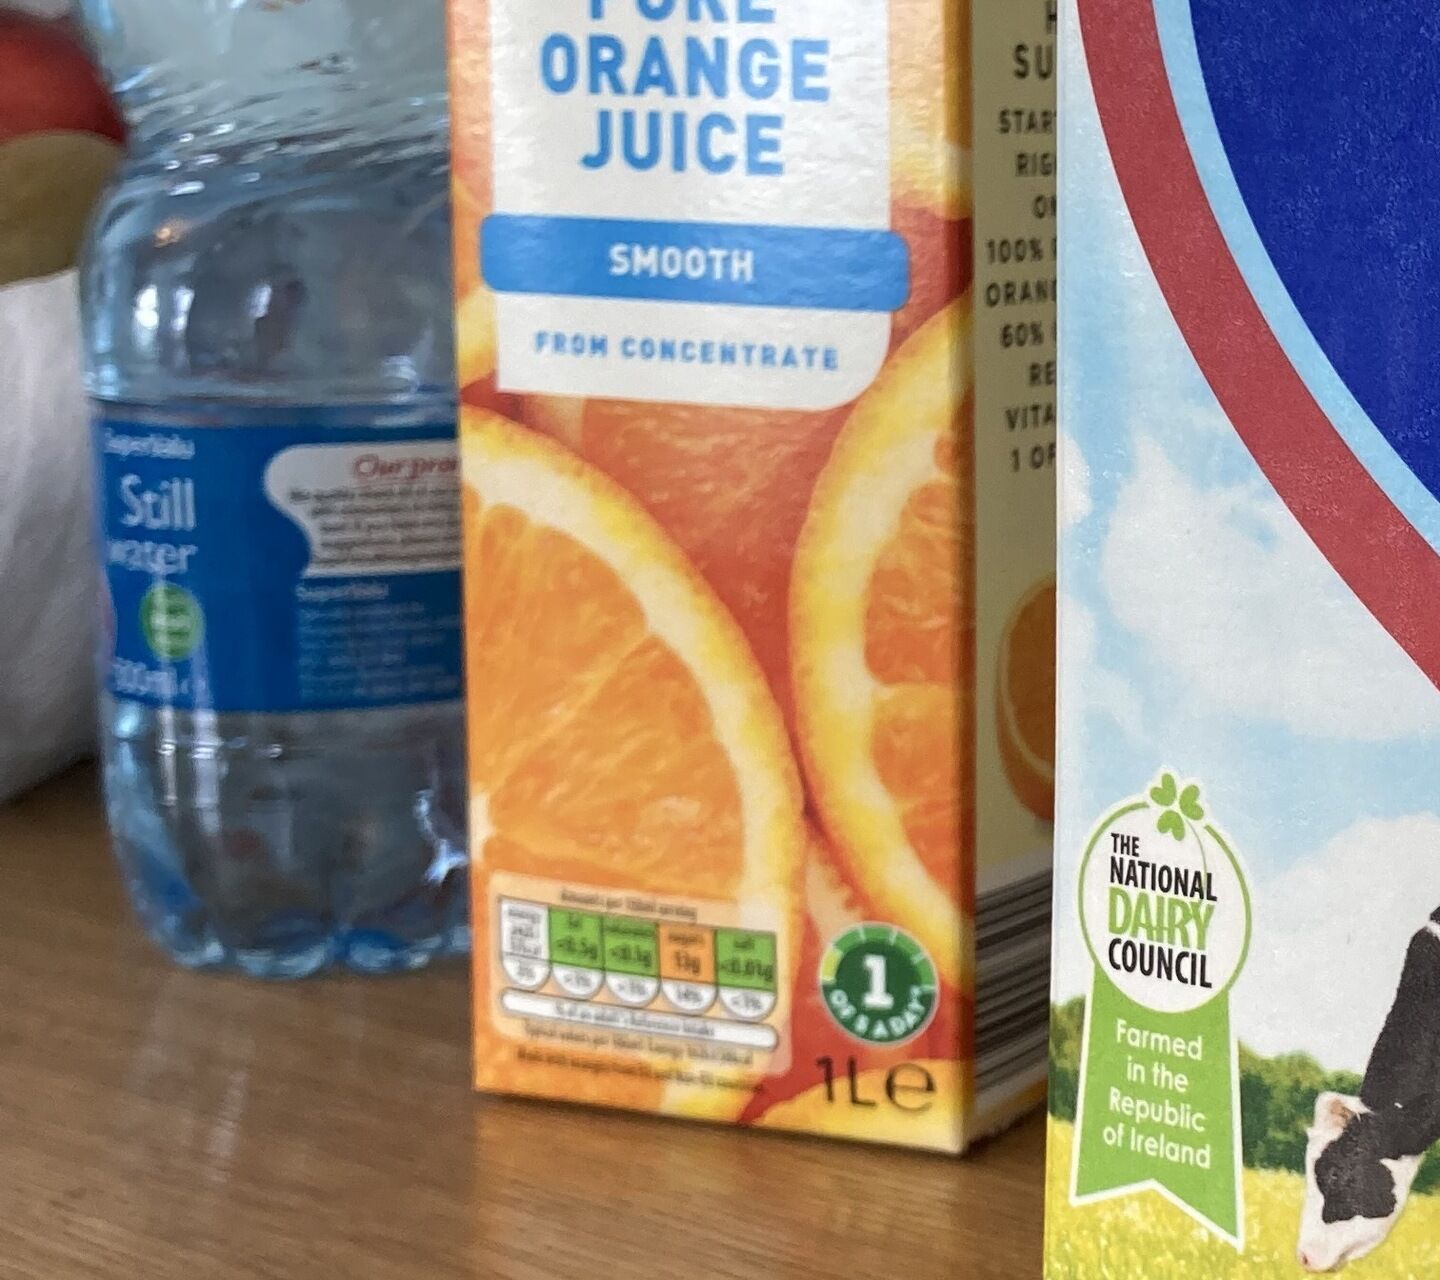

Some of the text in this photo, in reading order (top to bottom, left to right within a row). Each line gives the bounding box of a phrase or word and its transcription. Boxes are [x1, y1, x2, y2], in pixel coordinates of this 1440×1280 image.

[539, 34, 831, 102] ORANGE
[1013, 43, 1055, 80] SU
[998, 109, 1057, 134] STAR
[580, 109, 786, 177] JUICE
[1015, 152, 1057, 177] RIG
[608, 242, 755, 283] SMOOTH
[985, 238, 1044, 265] 100%
[985, 280, 1057, 308] ORAN
[535, 331, 839, 372] FROM CONCENTRATE
[1001, 322, 1045, 349] 60%
[1005, 403, 1057, 431] VITA
[1010, 449, 1021, 472] 1
[119, 472, 196, 532] Still
[1110, 832, 1140, 858] THE
[1109, 855, 1218, 903] NATIONAL
[1107, 886, 1216, 952] DAIRY
[862, 953, 895, 1011] 1
[1107, 937, 1214, 990] COUNCIL
[1115, 1018, 1203, 1062] Farmed
[815, 1054, 878, 1108] 1L
[1126, 1054, 1190, 1094] in the
[1109, 1087, 1207, 1134] Republic
[1102, 1125, 1212, 1170] of Ireland
